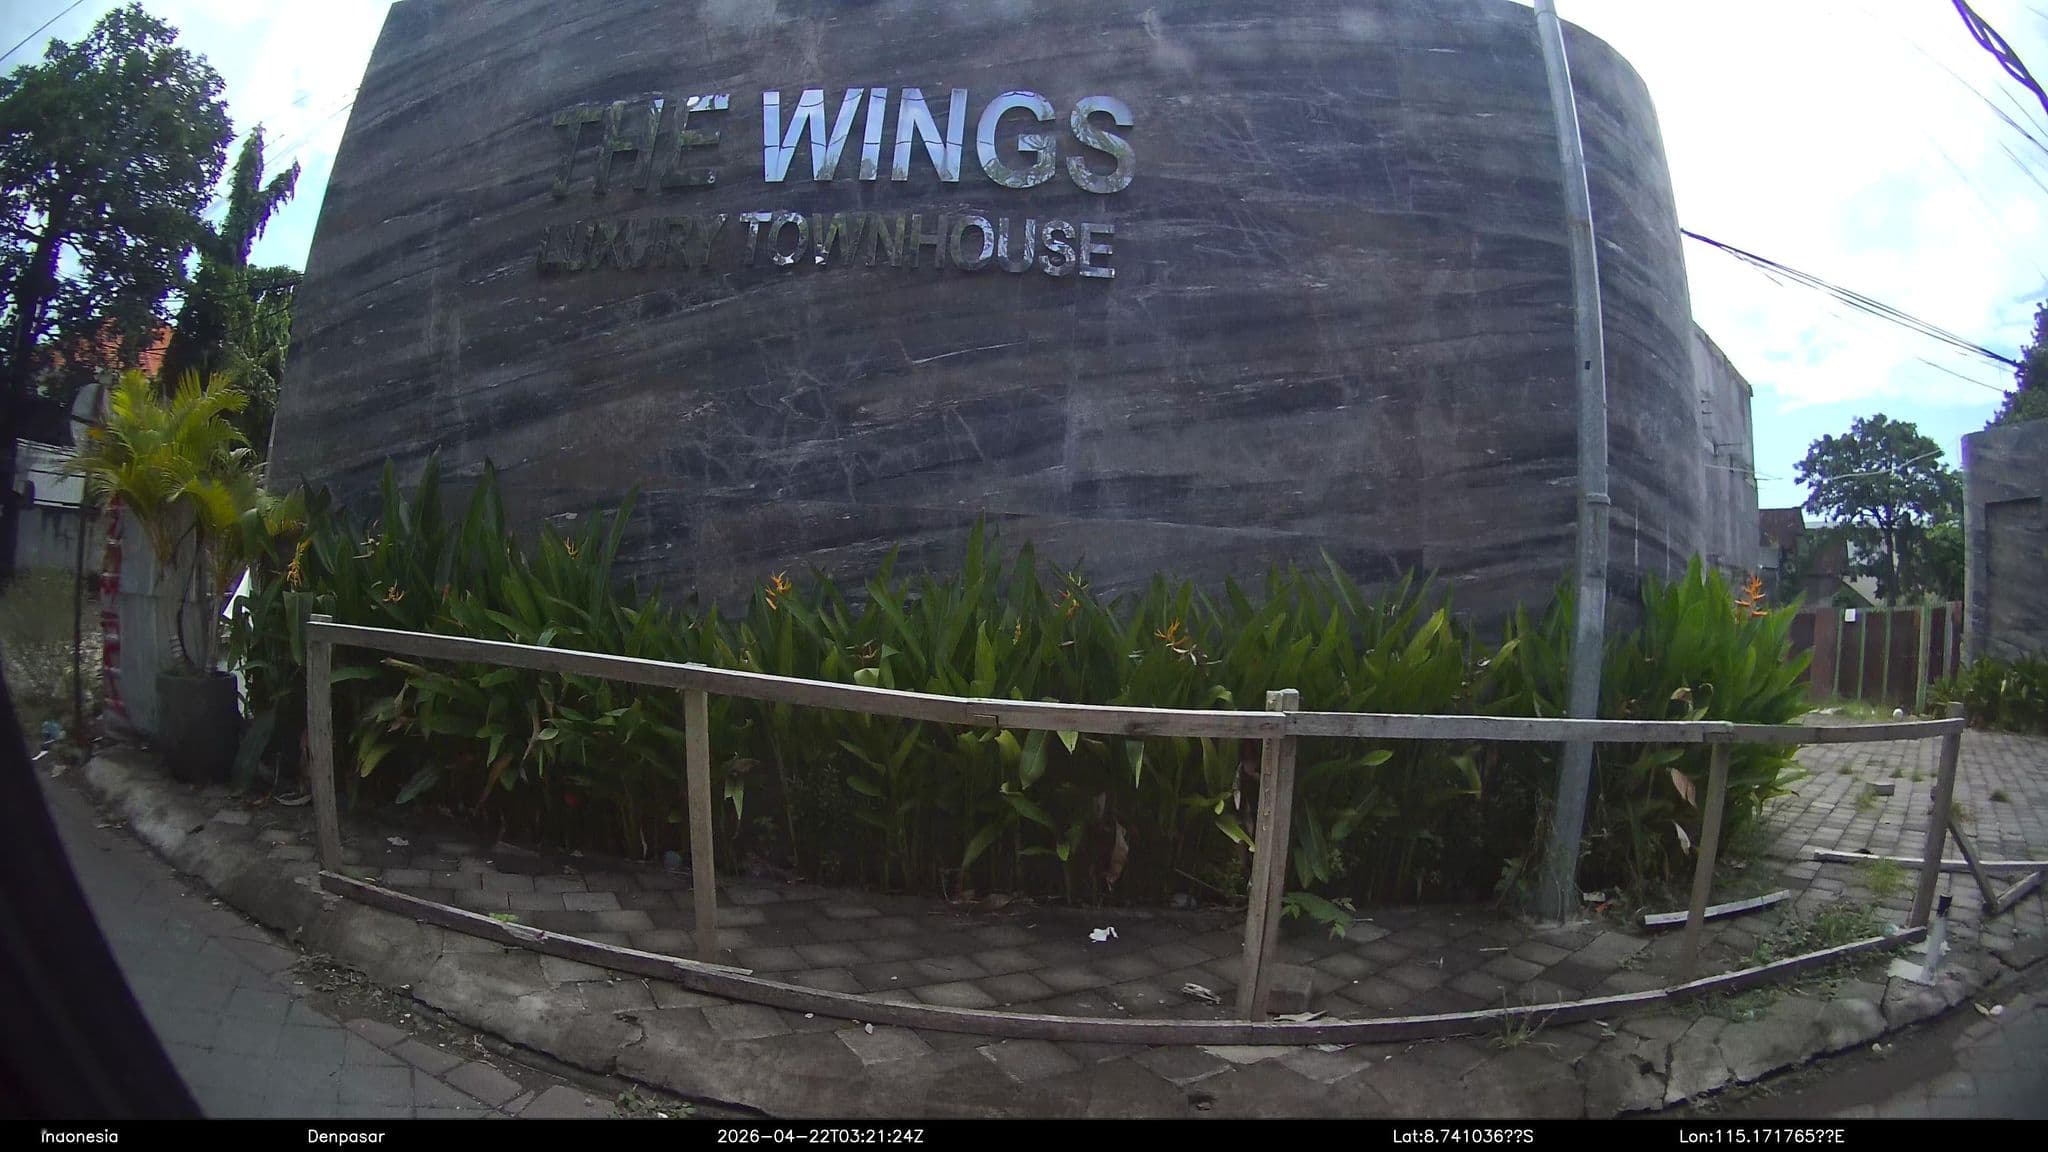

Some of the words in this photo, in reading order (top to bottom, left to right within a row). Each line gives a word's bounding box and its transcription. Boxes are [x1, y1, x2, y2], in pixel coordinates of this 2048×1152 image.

[550, 92, 731, 198] THE
[763, 88, 1136, 194] WINGS
[536, 212, 729, 273] LUXURY
[739, 210, 1117, 279] TOWNHOUSE
